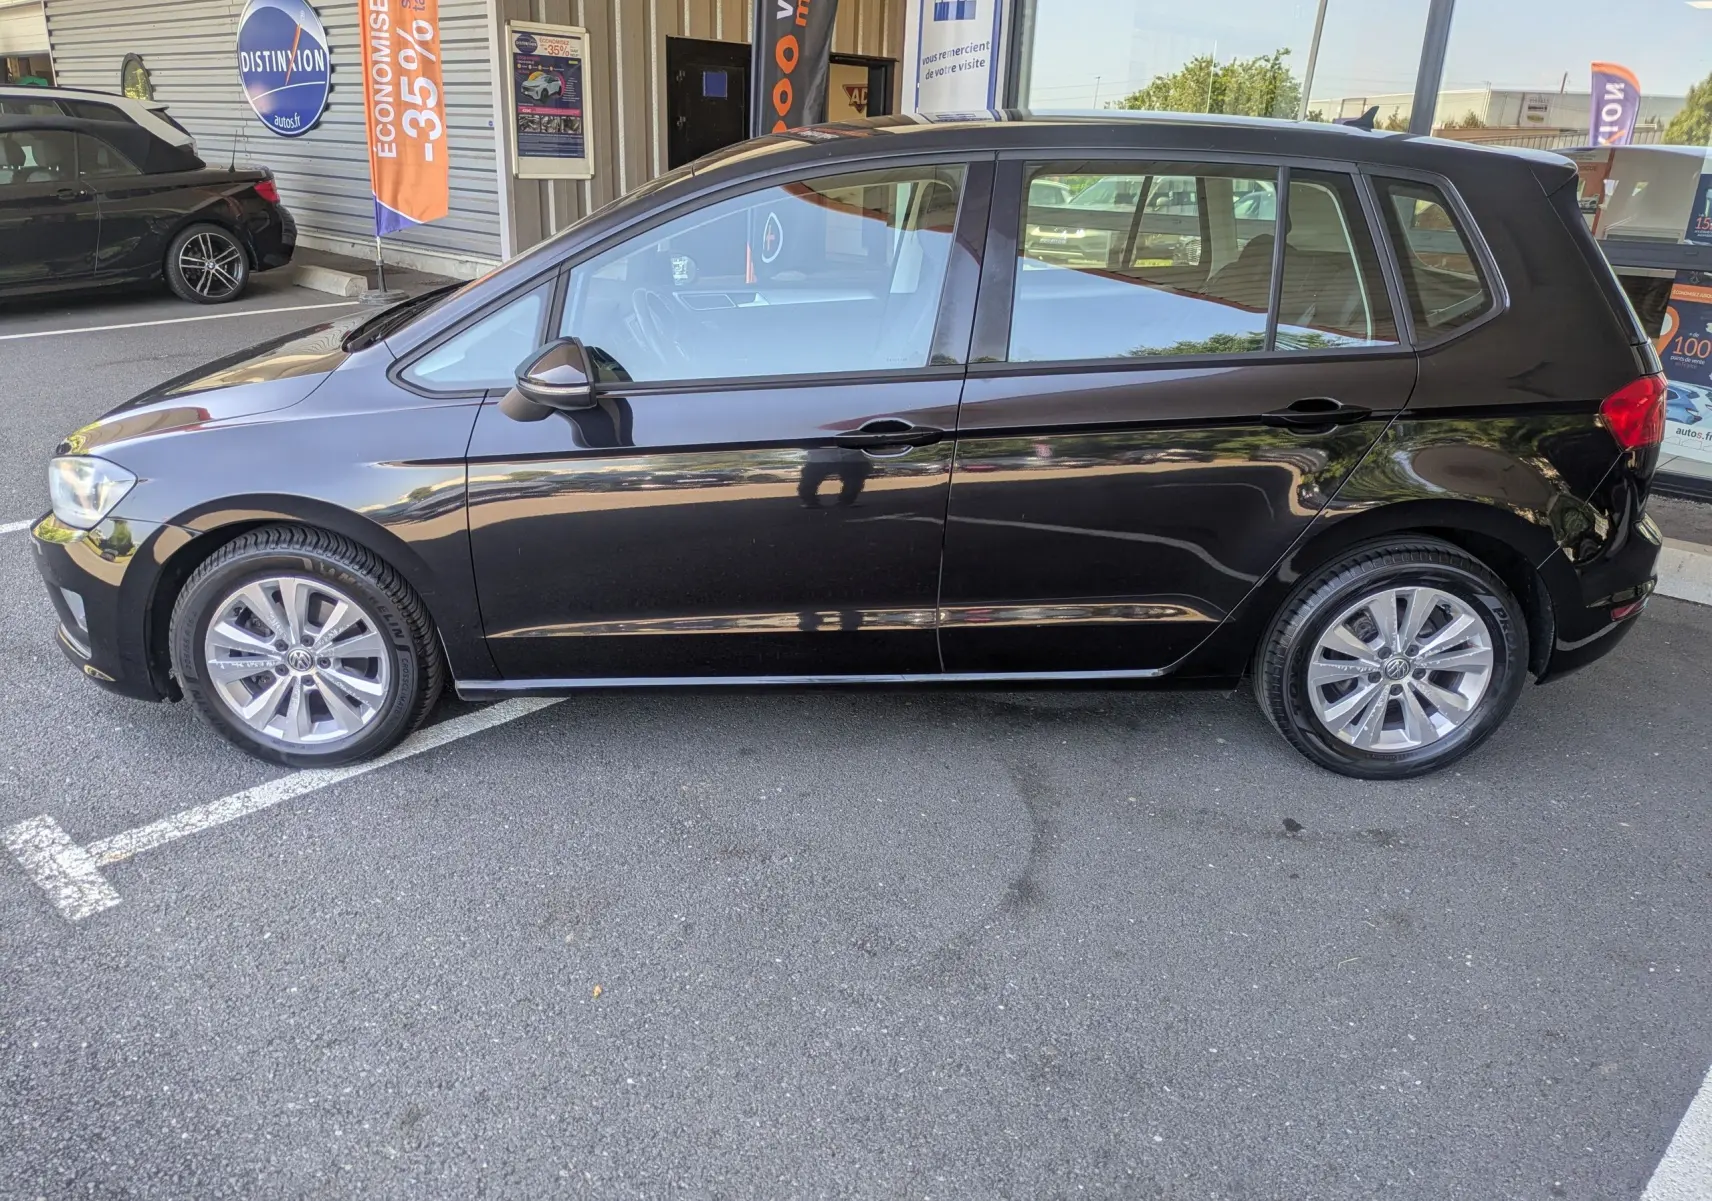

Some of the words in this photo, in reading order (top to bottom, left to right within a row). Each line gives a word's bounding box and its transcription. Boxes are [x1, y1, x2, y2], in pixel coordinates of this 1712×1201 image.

[240, 49, 325, 73] DISTINXION
[921, 53, 938, 66] vous
[938, 40, 991, 61] remercient
[925, 68, 934, 80] de
[934, 64, 957, 77] votre
[958, 57, 986, 72] visite
[274, 112, 301, 129] autos.fr
[1672, 336, 1711, 359] 100
